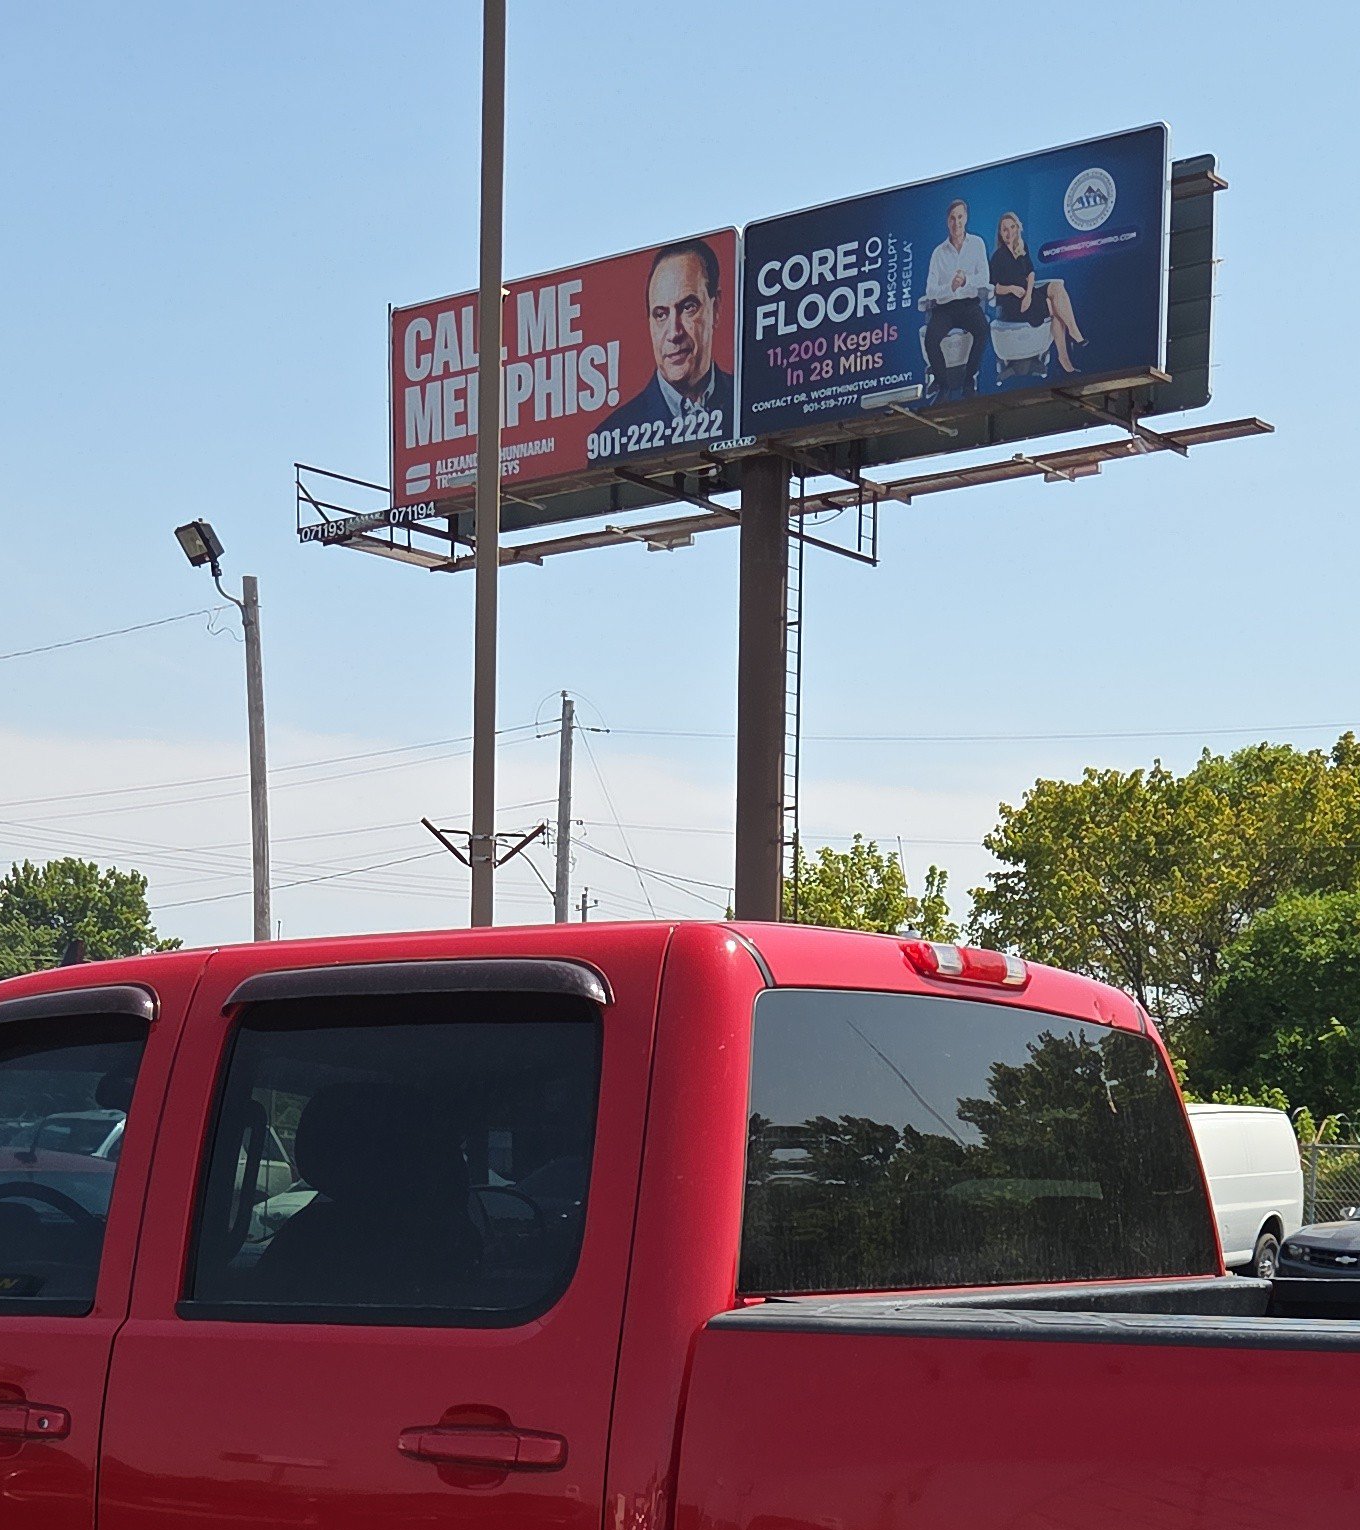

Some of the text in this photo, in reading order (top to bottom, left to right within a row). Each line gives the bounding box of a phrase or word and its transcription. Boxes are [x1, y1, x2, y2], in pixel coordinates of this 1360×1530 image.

[757, 236, 882, 297] CORE to
[516, 279, 583, 358] ME
[755, 280, 881, 340] FLOOR
[767, 322, 898, 369] 11,200 Kegels
[786, 351, 884, 387] In 28 Mins
[751, 395, 792, 413] CONTACT
[810, 378, 878, 400] WORTHINGTON
[586, 409, 723, 460] 901-222-2222
[709, 437, 754, 452] LAMAR
[301, 520, 345, 542] 071193
[389, 501, 436, 524] 071194
